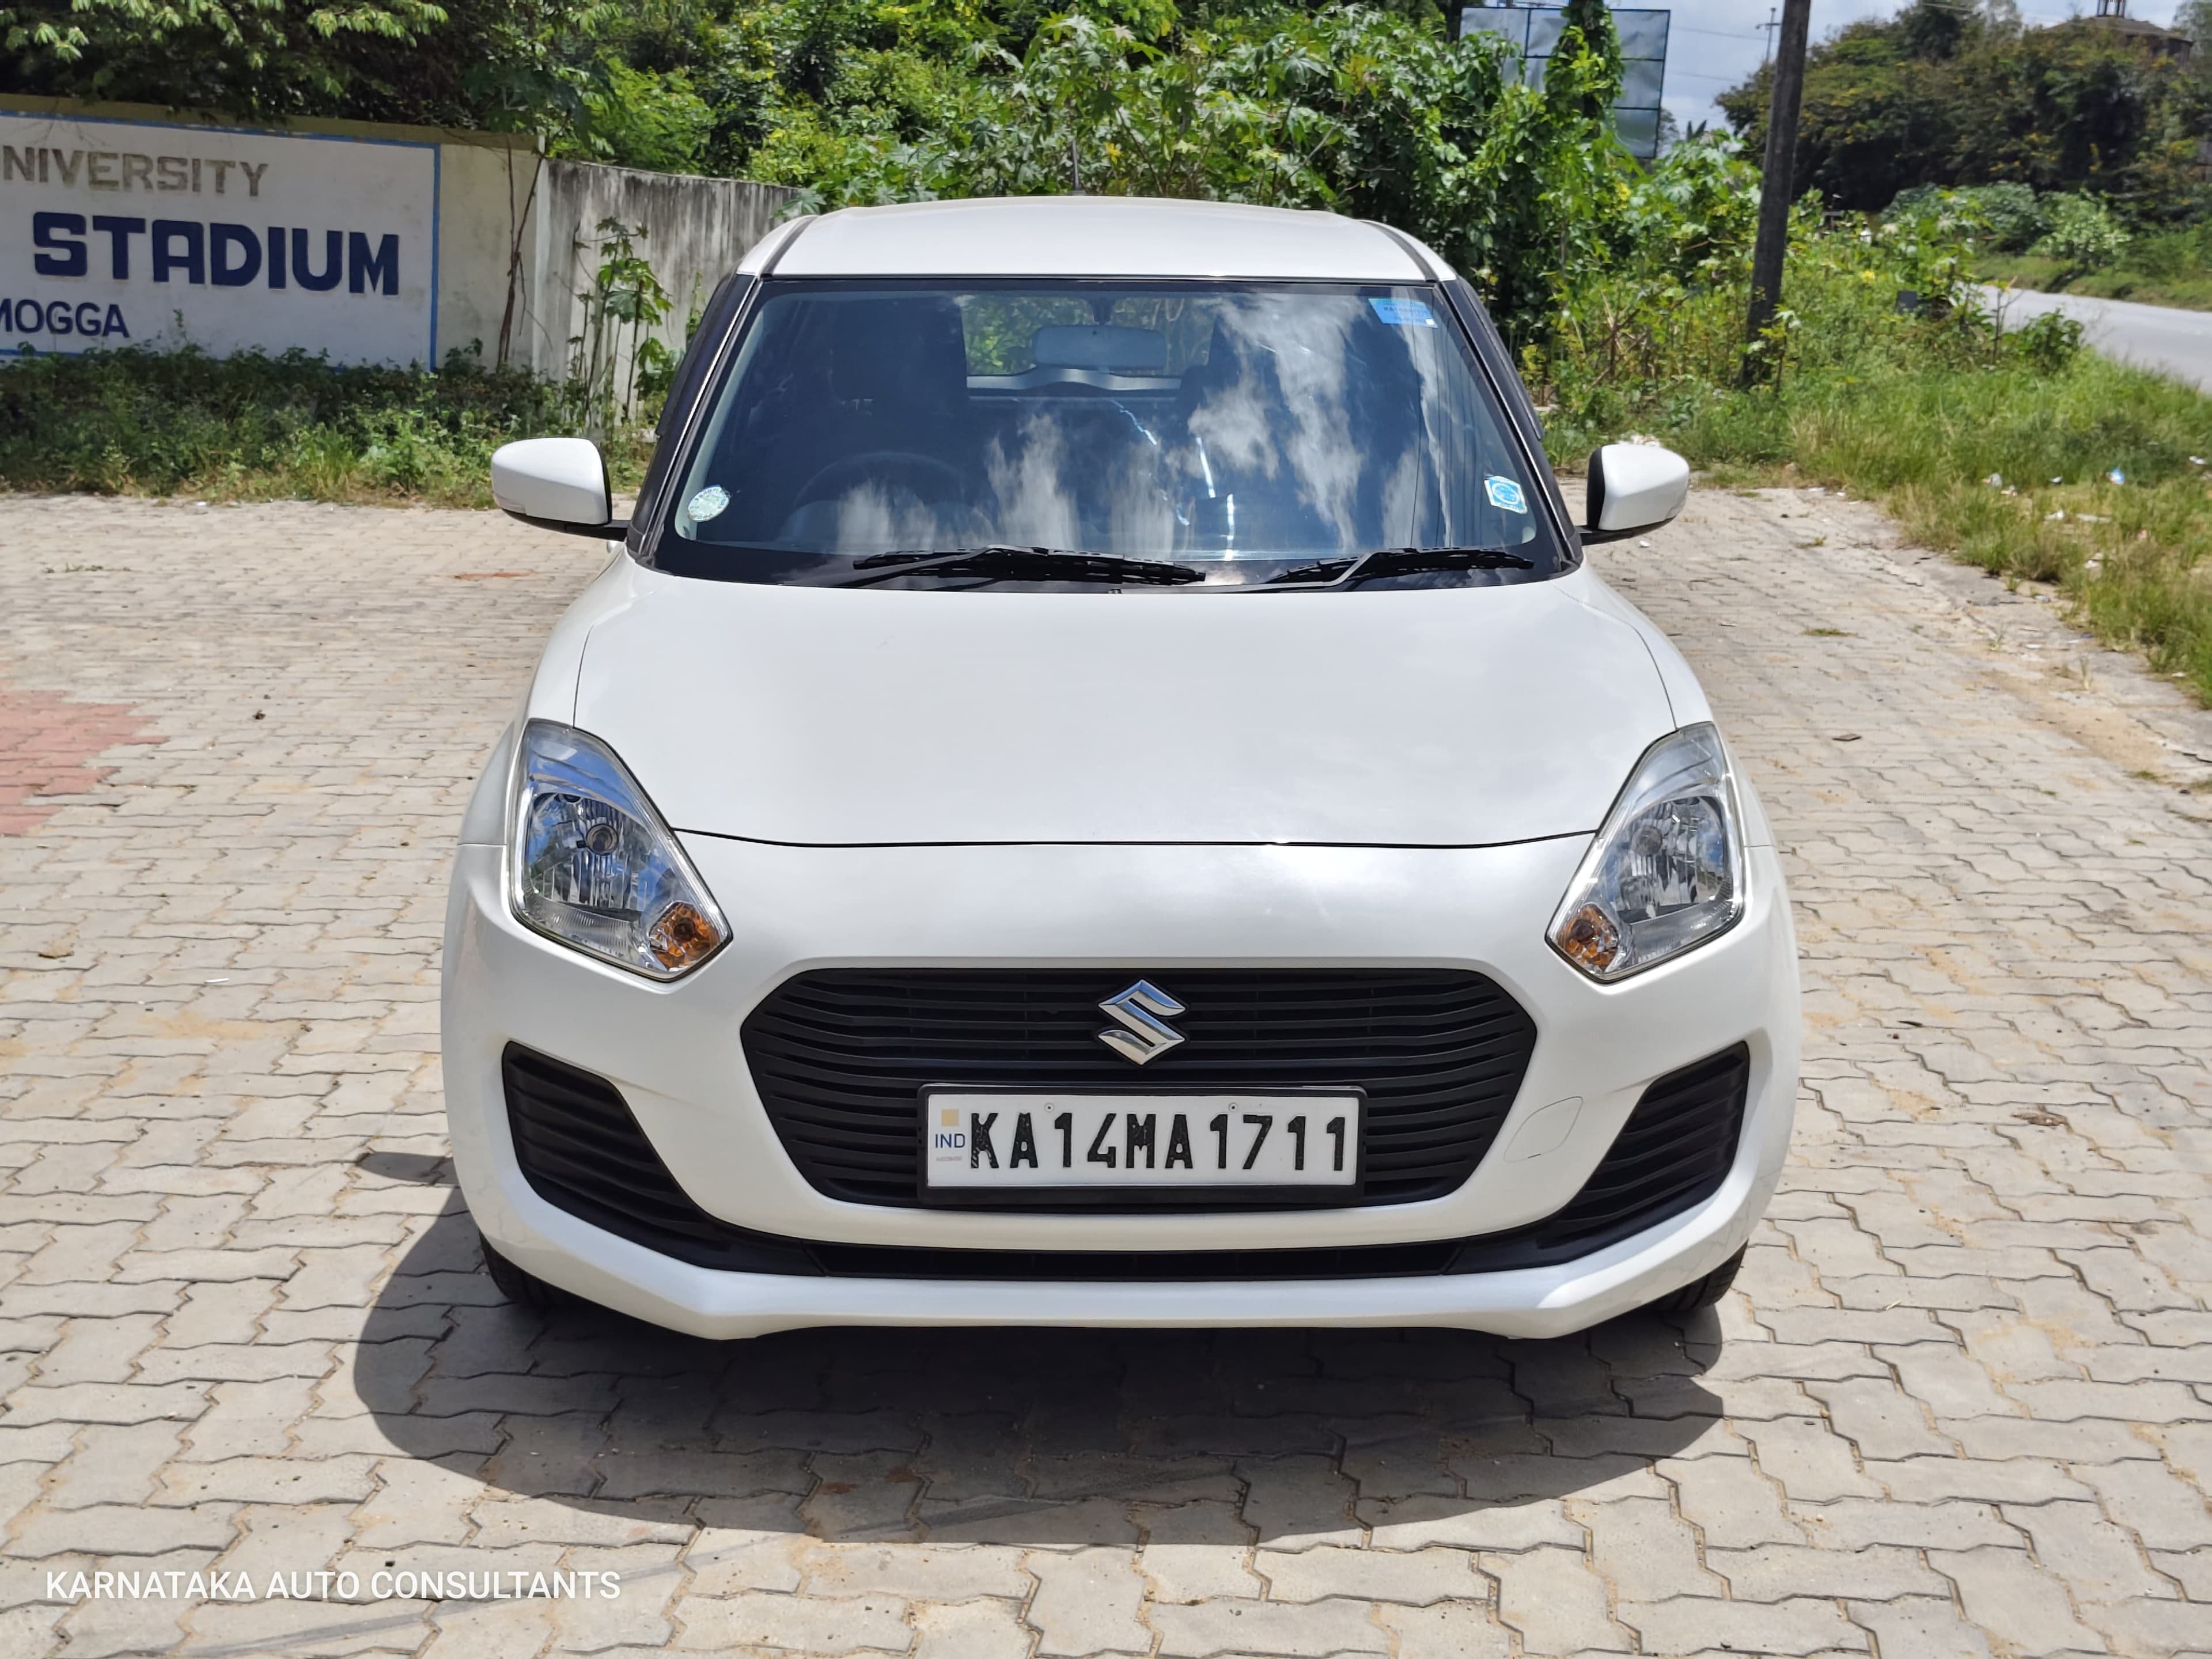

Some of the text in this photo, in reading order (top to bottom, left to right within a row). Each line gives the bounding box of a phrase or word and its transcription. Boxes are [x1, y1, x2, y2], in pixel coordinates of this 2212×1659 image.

[33, 211, 399, 296] STADIUM
[935, 1133, 966, 1149] IND
[970, 1112, 1346, 1172] KA14MA1711
